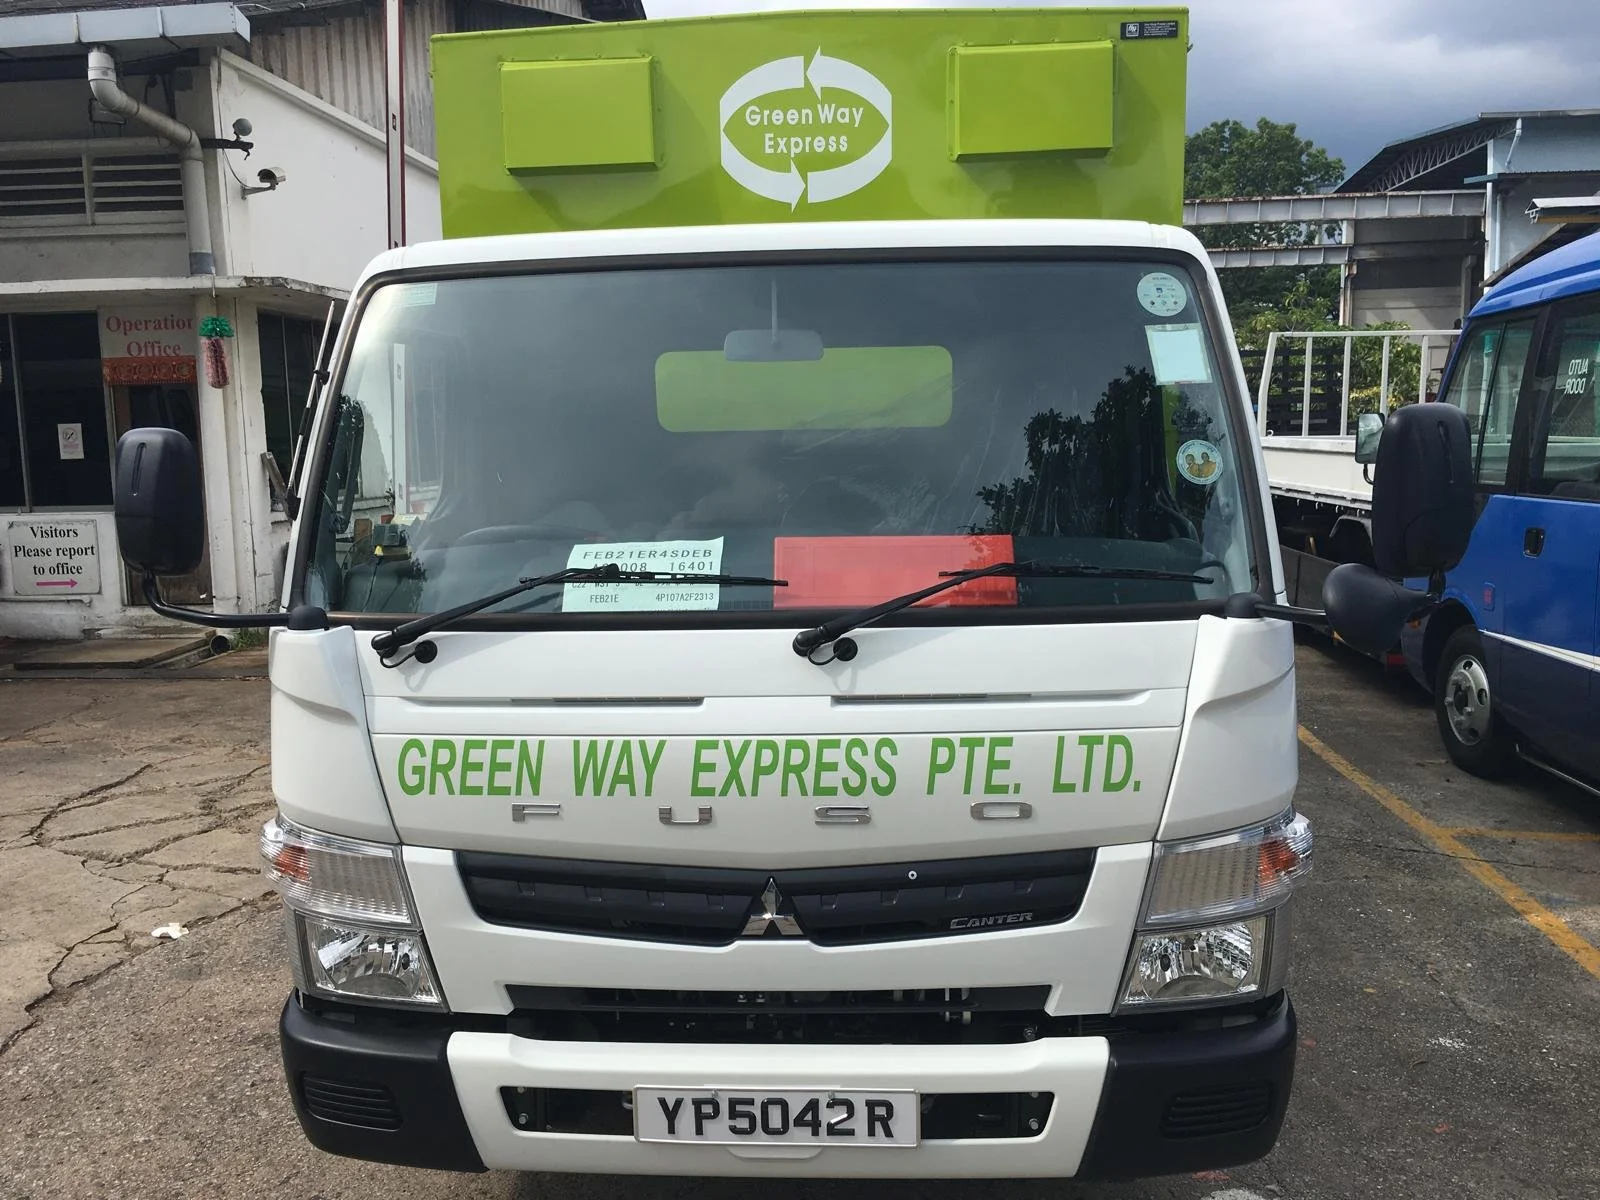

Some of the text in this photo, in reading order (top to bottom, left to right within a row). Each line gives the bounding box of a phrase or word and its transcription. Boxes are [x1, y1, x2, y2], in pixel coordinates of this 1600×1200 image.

[745, 103, 864, 128] Green Way
[764, 133, 849, 158] Express
[126, 340, 181, 358] Office
[29, 526, 79, 539] Visitors
[14, 544, 95, 560] Please report
[583, 549, 713, 560] FEB21ER4SDEB
[33, 562, 83, 576] to office
[669, 561, 713, 572] 16401
[589, 594, 620, 604] FEB21E
[397, 734, 1141, 797] GREEN WAY EXPRESS PTE. LTD.
[511, 801, 1033, 826] FUSO
[950, 912, 1034, 929] CANTER
[656, 1096, 894, 1139] YP5042R
